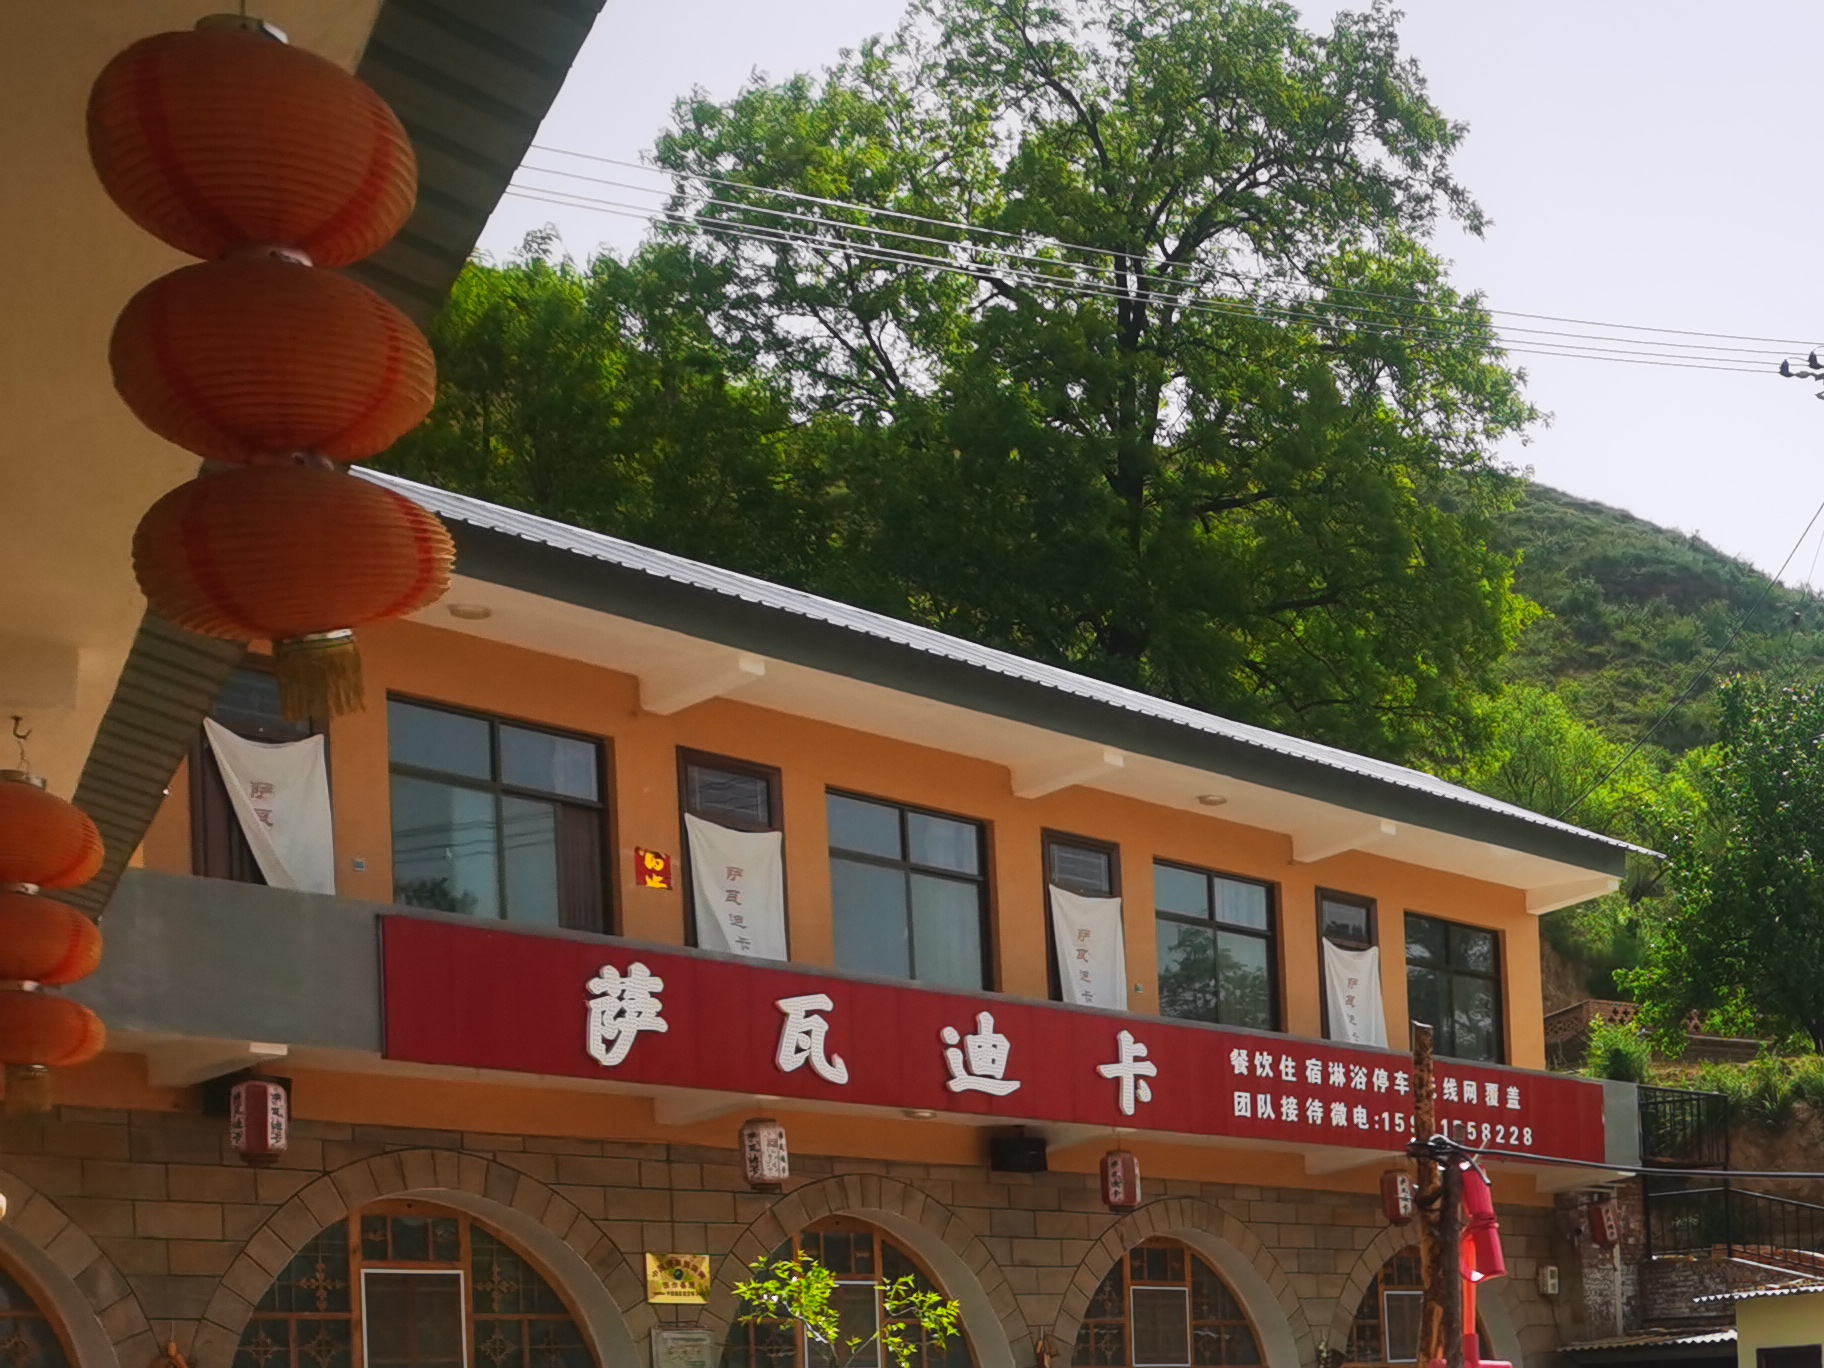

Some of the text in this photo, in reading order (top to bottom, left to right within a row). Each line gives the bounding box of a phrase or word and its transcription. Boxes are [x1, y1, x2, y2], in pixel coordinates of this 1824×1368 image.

[585, 961, 1158, 1116] 萨瓦迪卡
[1229, 1047, 1521, 1110] 餐饮住宿淋浴停车线网覆盖
